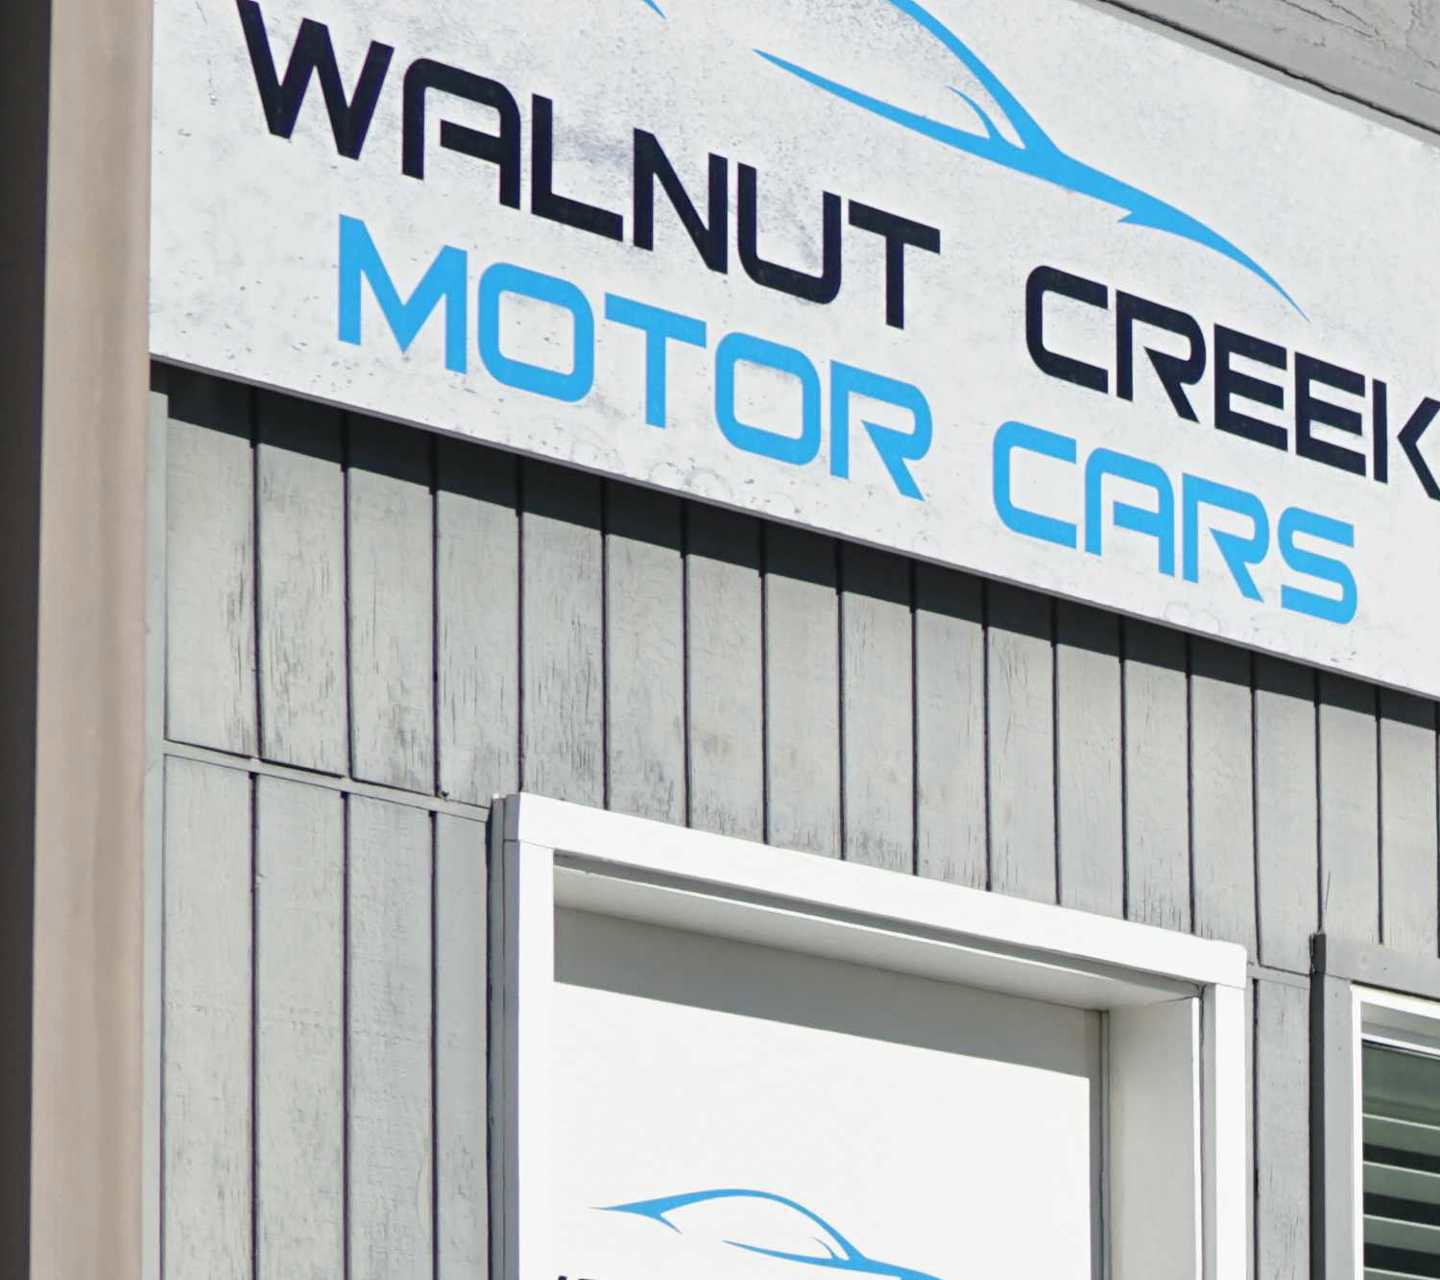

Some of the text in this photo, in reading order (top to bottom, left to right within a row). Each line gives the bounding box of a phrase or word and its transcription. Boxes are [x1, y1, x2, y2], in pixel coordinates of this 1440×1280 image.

[237, 0, 941, 329] WALNUT
[338, 215, 1358, 624] MOTOR CARS
